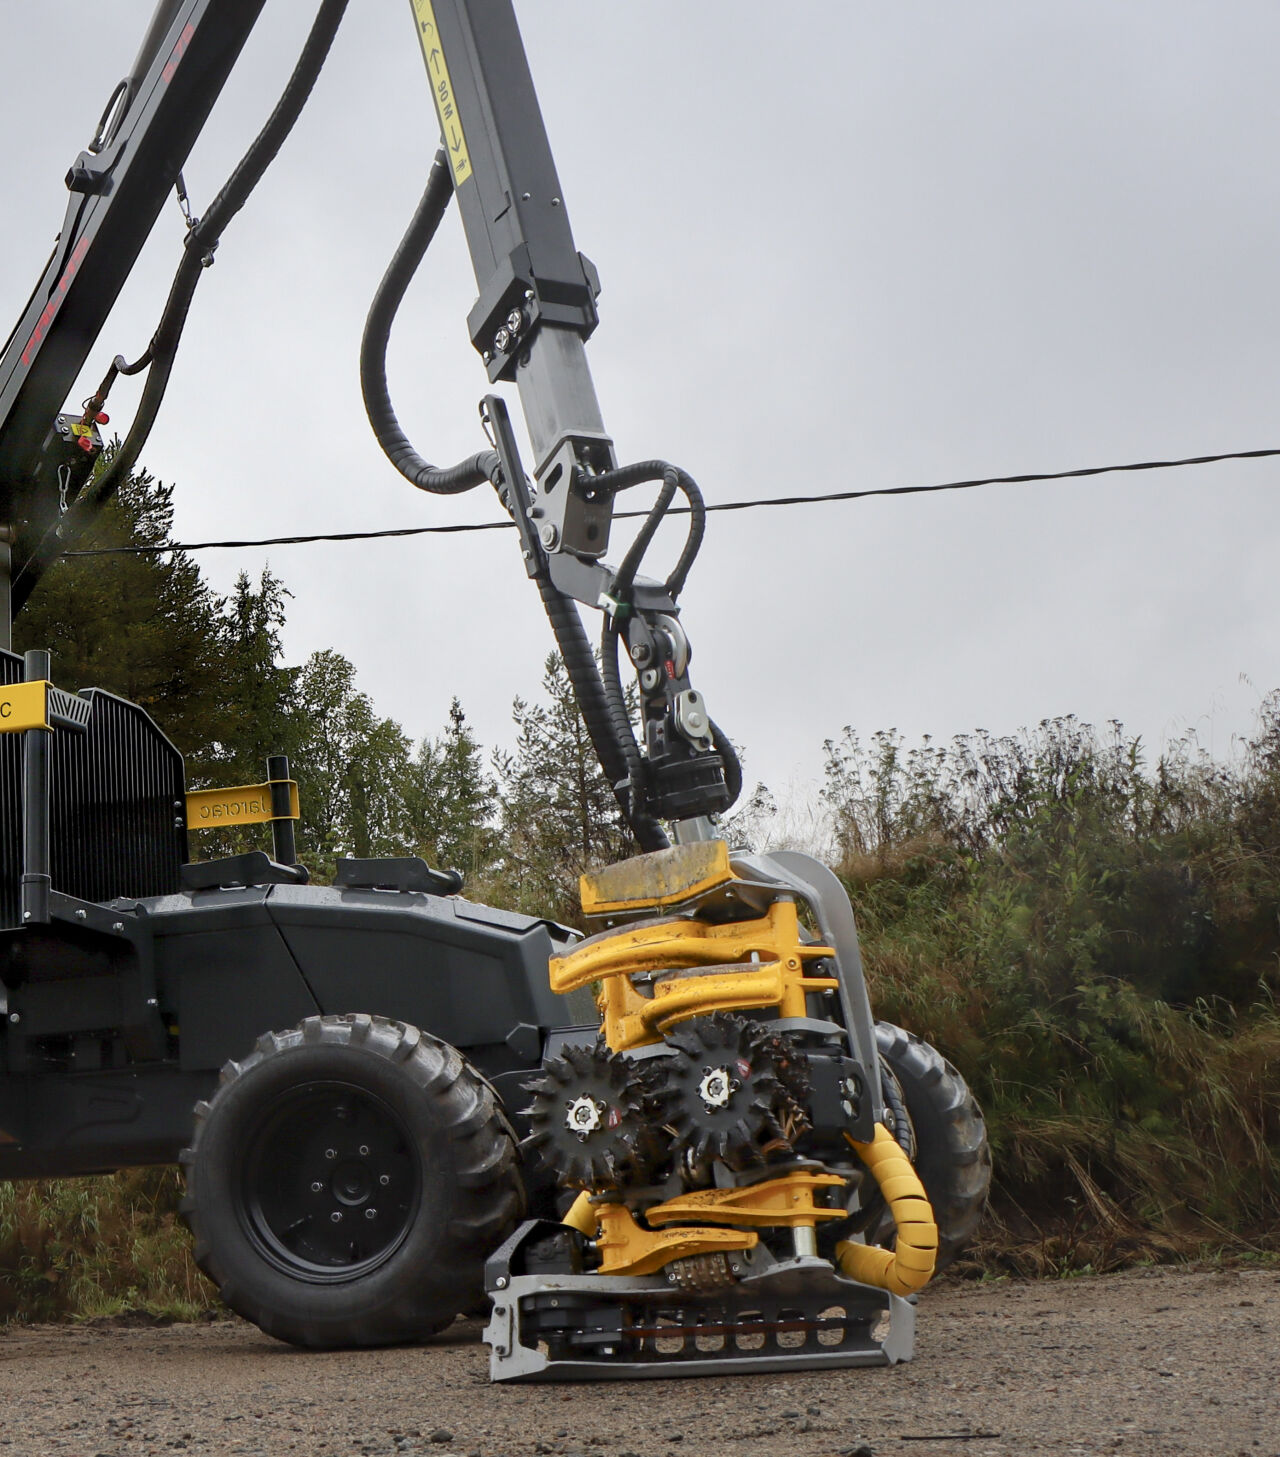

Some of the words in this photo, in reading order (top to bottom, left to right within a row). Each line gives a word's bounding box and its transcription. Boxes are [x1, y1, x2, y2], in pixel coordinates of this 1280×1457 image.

[438, 80, 449, 102] 90
[443, 103, 454, 120] M
[21, 237, 89, 366] PALMS
